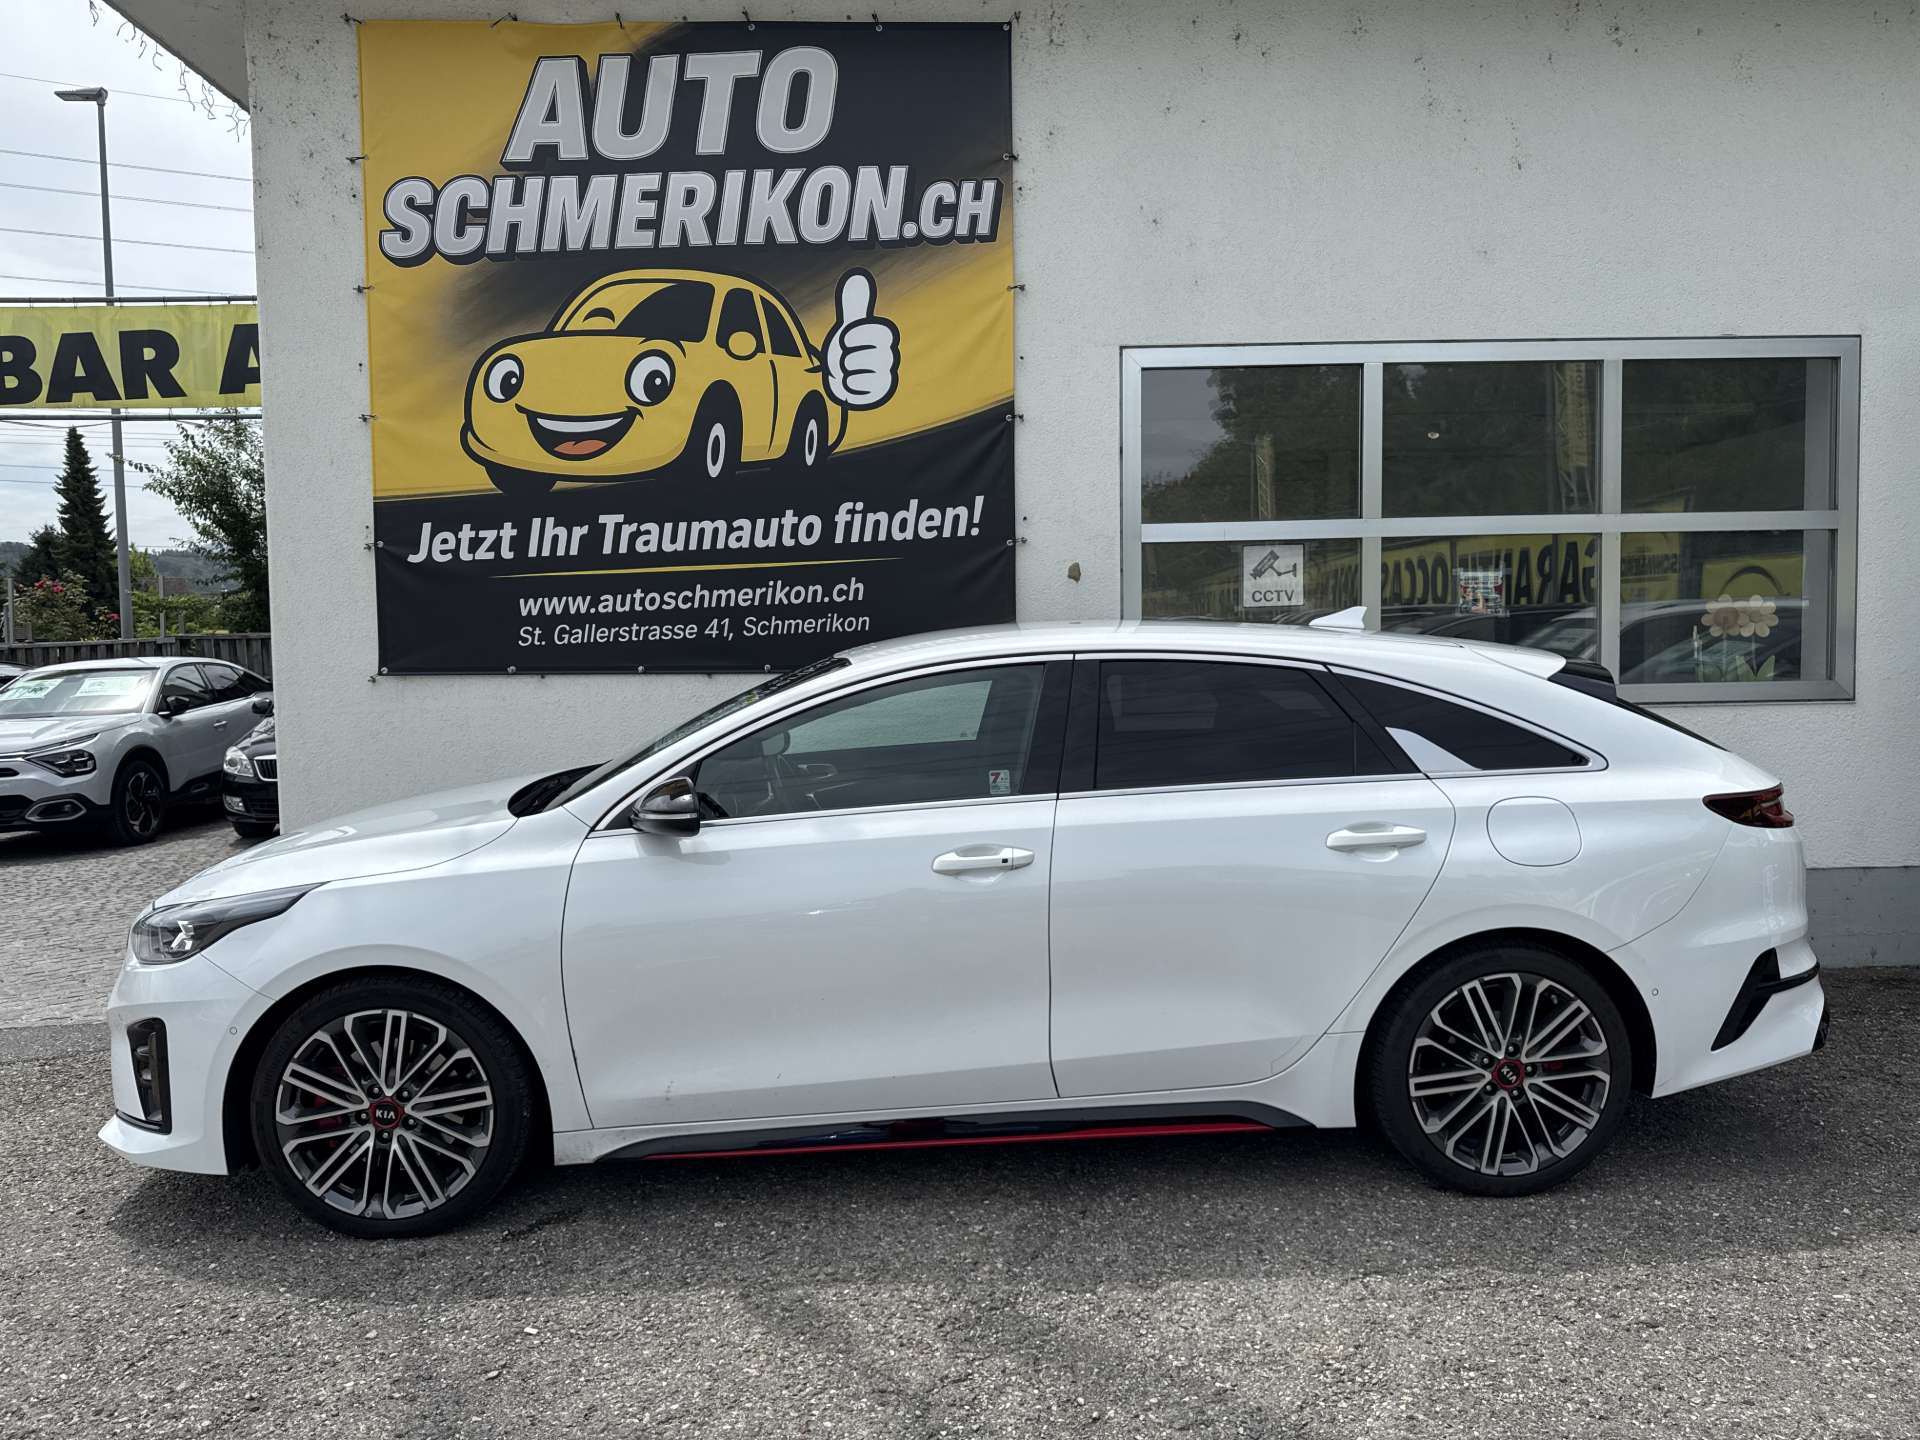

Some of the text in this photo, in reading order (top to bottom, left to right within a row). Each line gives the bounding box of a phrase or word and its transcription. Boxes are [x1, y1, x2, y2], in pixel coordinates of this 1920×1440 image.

[502, 45, 840, 166] AUTO
[381, 165, 1000, 261] SCHMERIKON.CH
[407, 495, 984, 563] Jetzt Ihr Traumauto finden!
[518, 577, 864, 616] www.autoschmerikon.ch
[1251, 589, 1295, 603] CCTV
[518, 613, 870, 647] St. Gallerstrasse 41, Schmerikon
[1501, 1065, 1517, 1083] KIA
[375, 1109, 396, 1120] KIA
